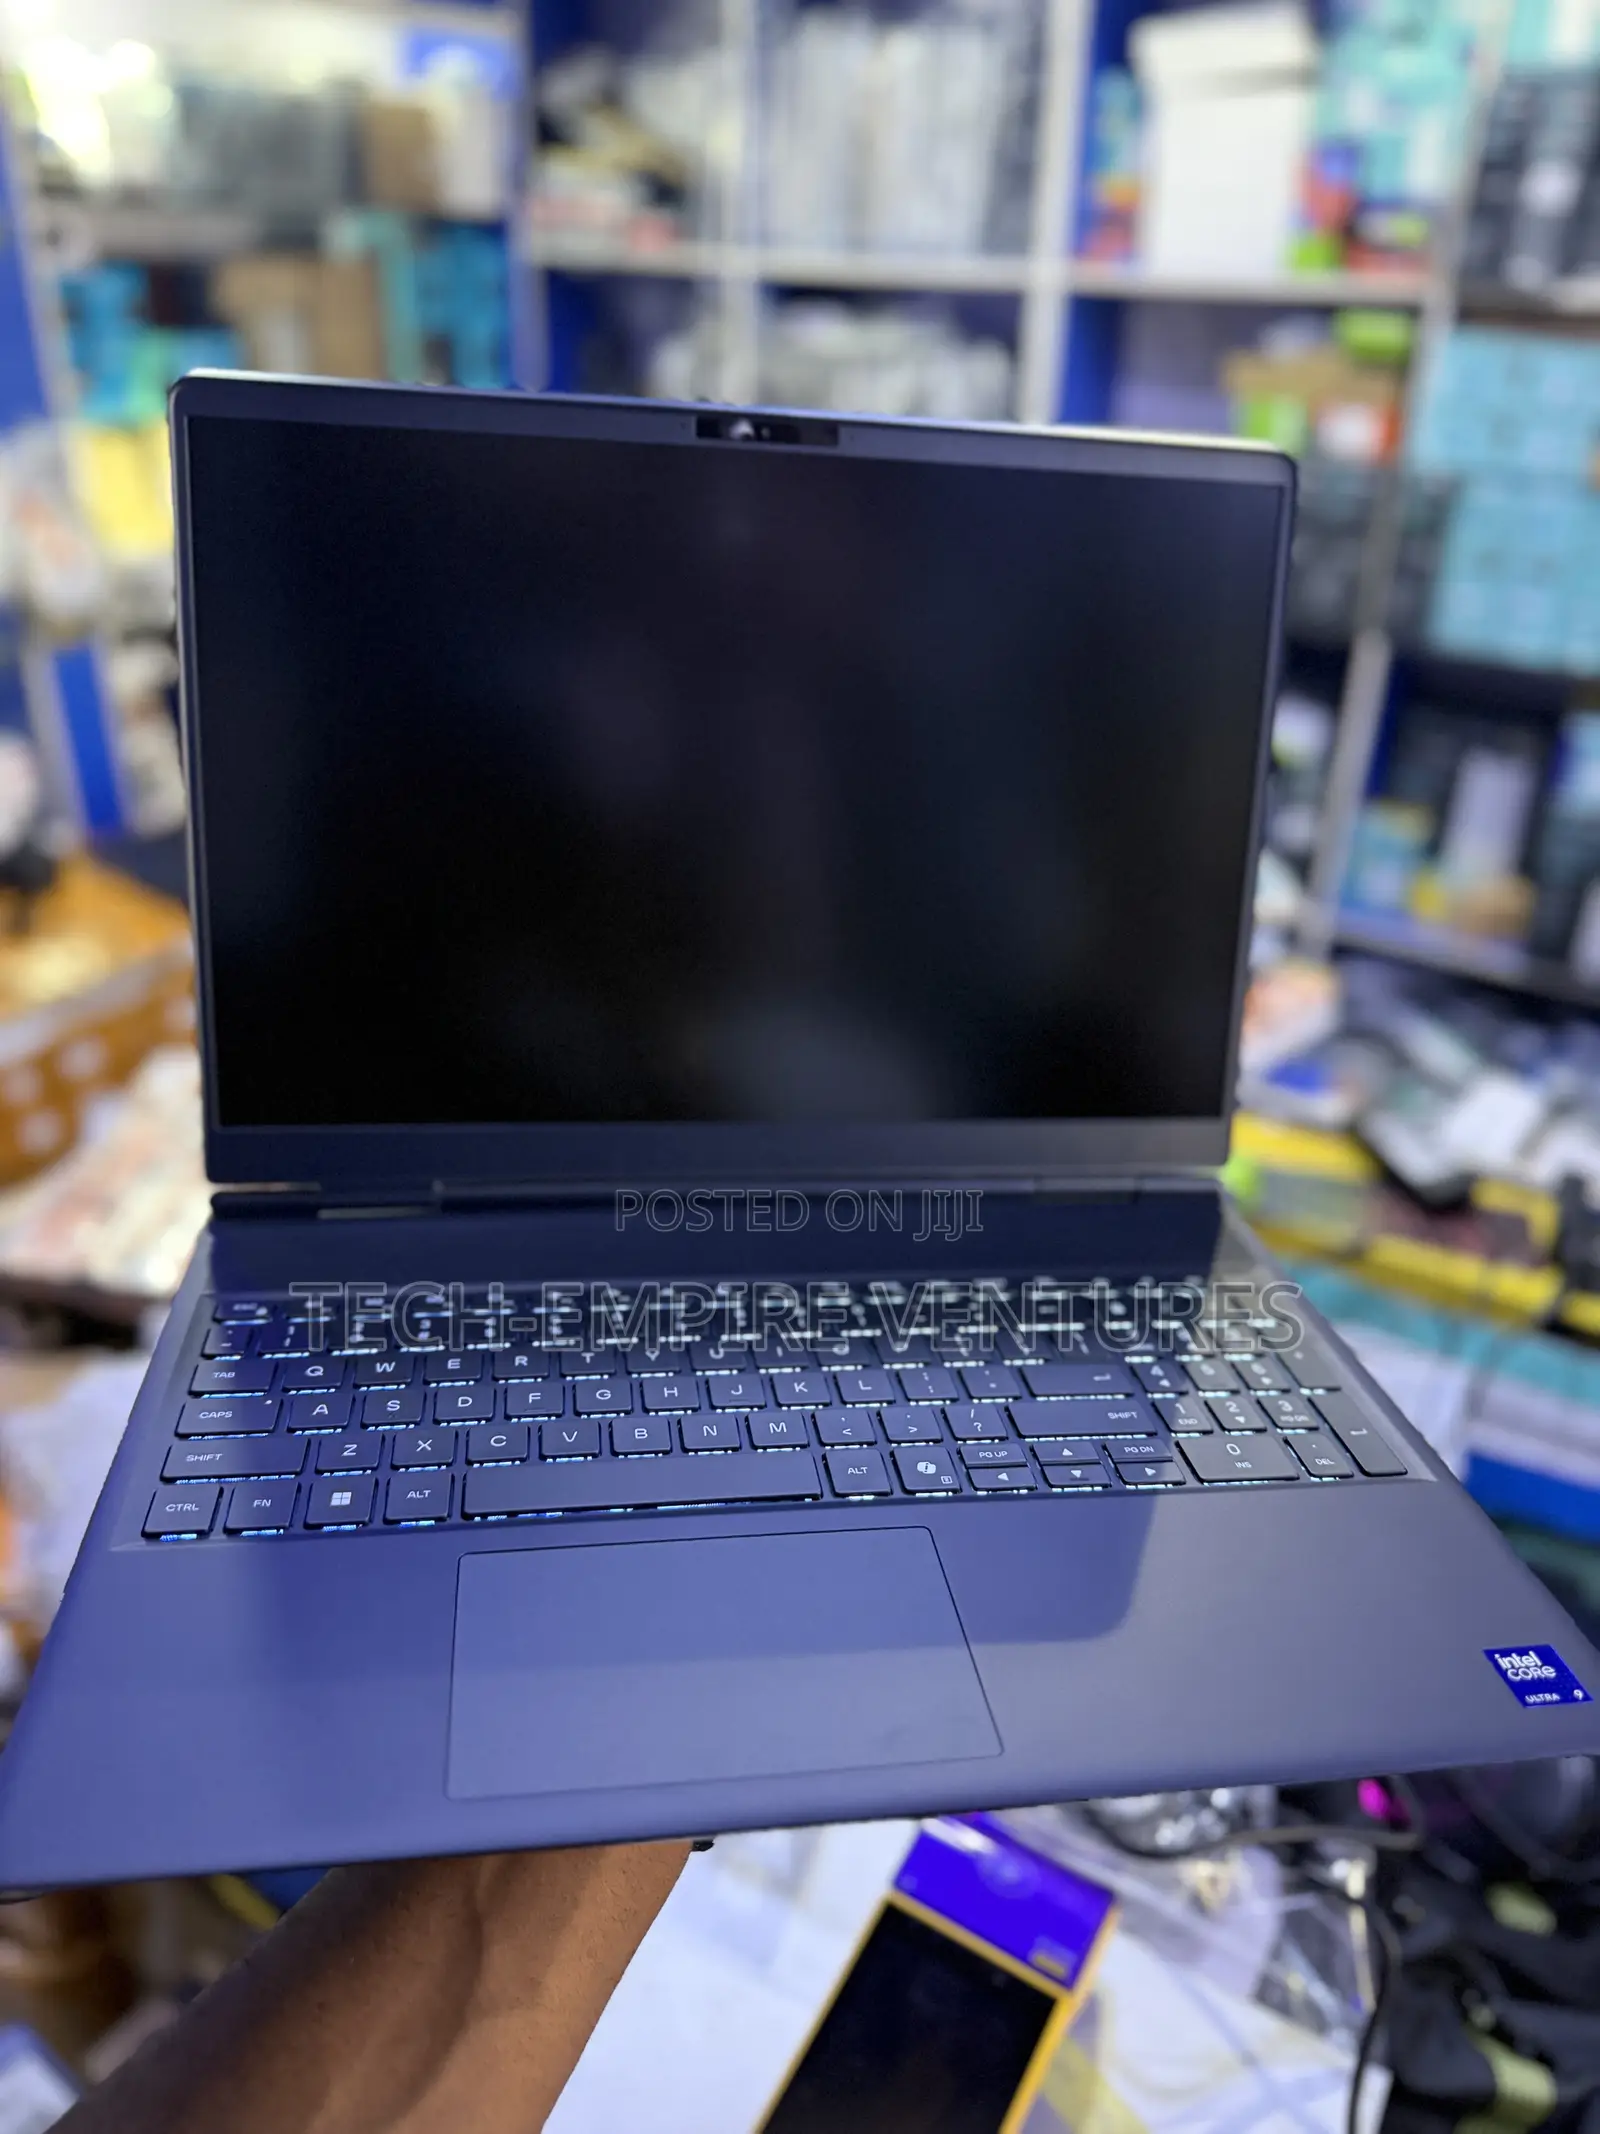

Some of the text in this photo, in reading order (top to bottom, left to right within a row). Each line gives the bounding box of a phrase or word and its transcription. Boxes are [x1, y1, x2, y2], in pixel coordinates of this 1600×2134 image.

[515, 1356, 528, 1366] R
[580, 1352, 596, 1364] T
[376, 1362, 395, 1372] W
[448, 1359, 460, 1369] E
[211, 1371, 236, 1379] TAB
[306, 1366, 323, 1376] Q
[731, 1385, 742, 1395] J
[794, 1381, 808, 1392] K
[859, 1380, 872, 1390] L
[596, 1390, 611, 1400] G
[664, 1387, 678, 1397] H
[458, 1397, 472, 1407] D
[529, 1393, 541, 1403] F
[312, 1404, 328, 1415] A
[387, 1400, 400, 1411] S
[1226, 1401, 1240, 1412] 2
[703, 1425, 717, 1436] N
[770, 1422, 786, 1433] M
[563, 1431, 577, 1442] V
[635, 1429, 648, 1439] B
[417, 1440, 432, 1451] X
[491, 1436, 506, 1446] C
[342, 1444, 357, 1456] Z
[407, 1490, 431, 1498] ALT
[1494, 1650, 1542, 1670] intel
[1525, 1693, 1560, 1703] ULTRA
